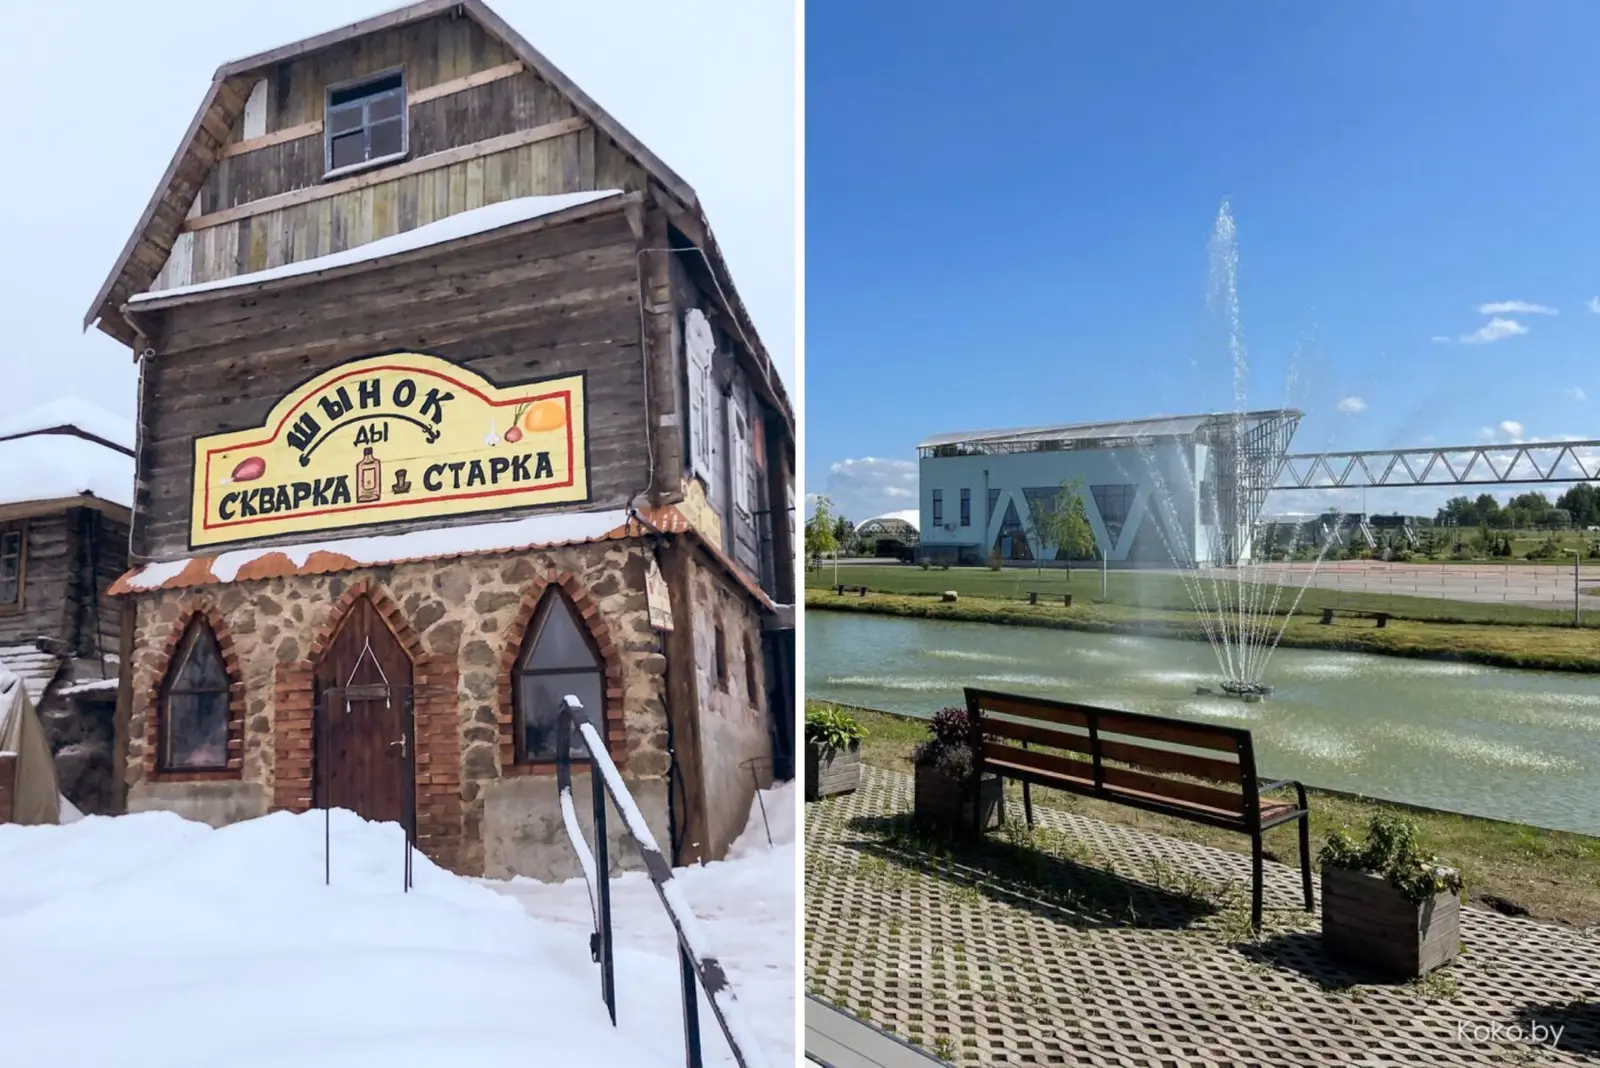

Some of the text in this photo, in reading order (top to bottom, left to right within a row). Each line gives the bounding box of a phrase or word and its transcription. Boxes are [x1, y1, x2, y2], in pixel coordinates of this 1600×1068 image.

[287, 378, 455, 452] ШЫНОК
[353, 421, 389, 447] ДЫ
[218, 451, 554, 520] СКВАРКА СТАРКА
